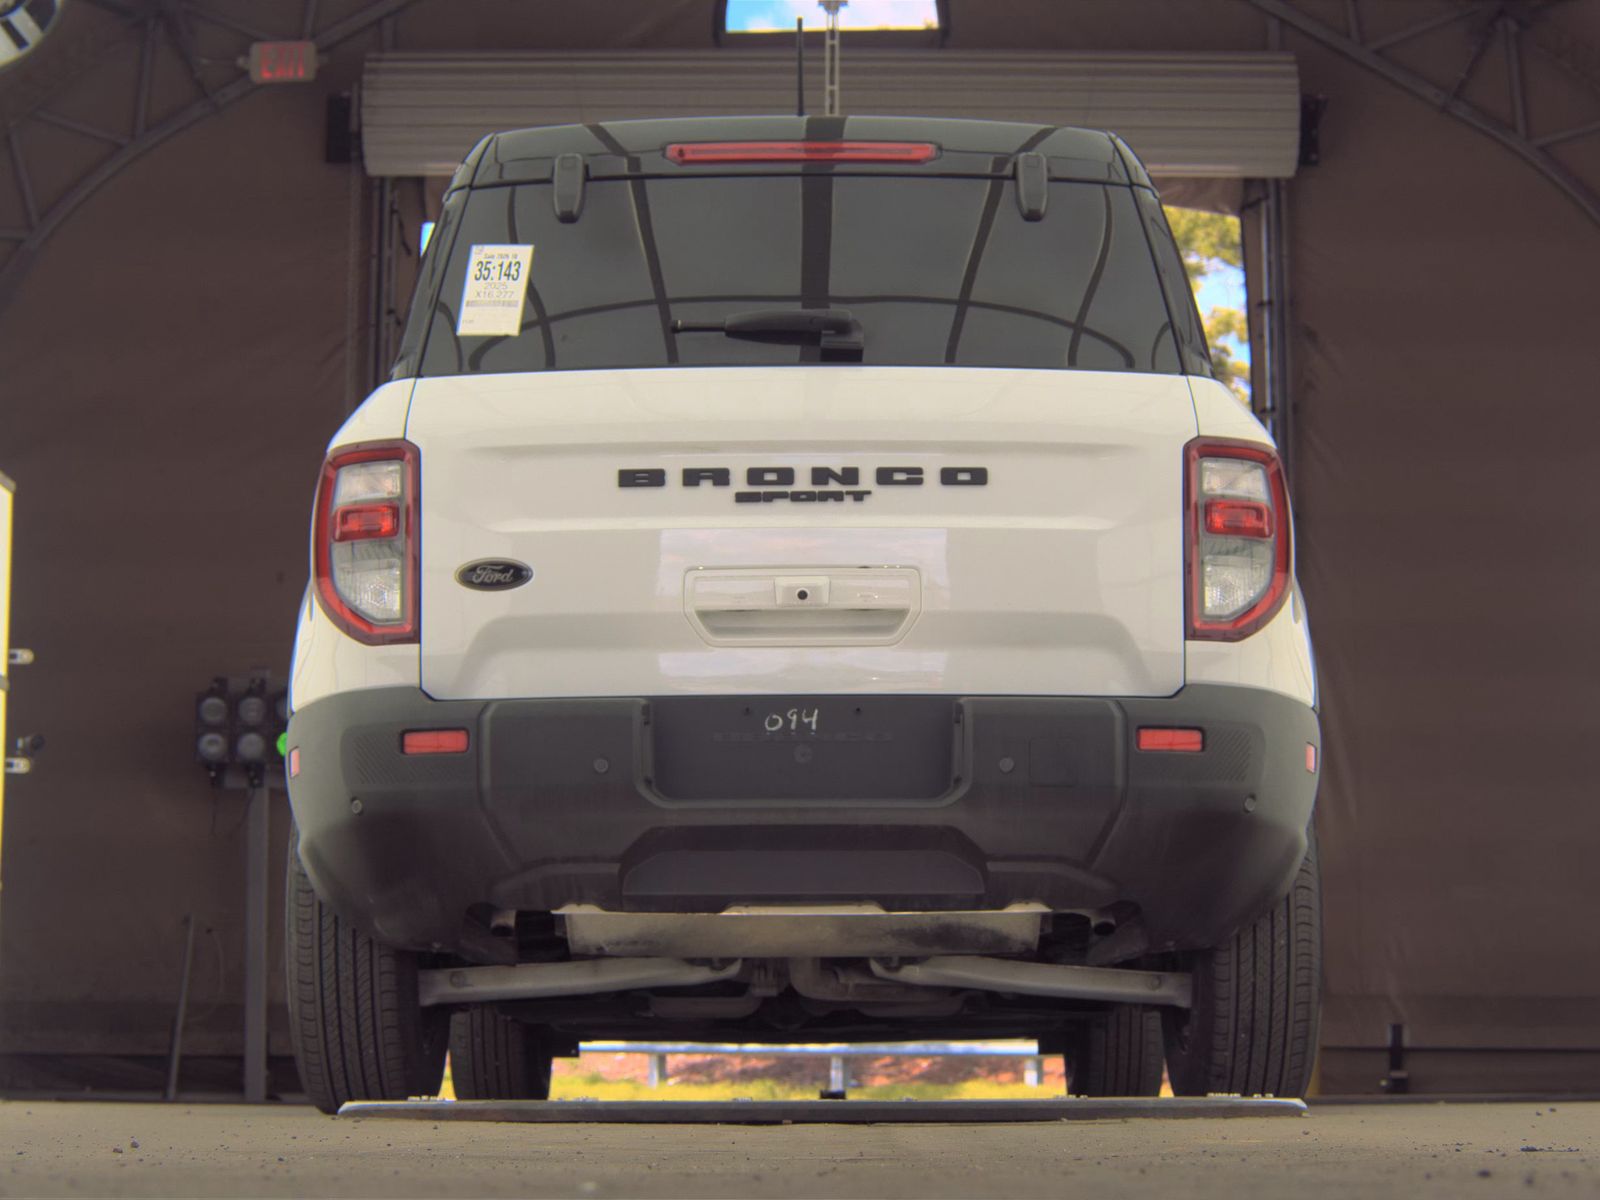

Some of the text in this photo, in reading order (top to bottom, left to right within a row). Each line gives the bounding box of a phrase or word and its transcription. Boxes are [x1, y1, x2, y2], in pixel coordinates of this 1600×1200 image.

[474, 260, 521, 281] 35:143
[618, 467, 988, 487] BRONCO
[735, 490, 872, 503] SPORT
[472, 565, 515, 584] Ford
[764, 708, 819, 731] 094
